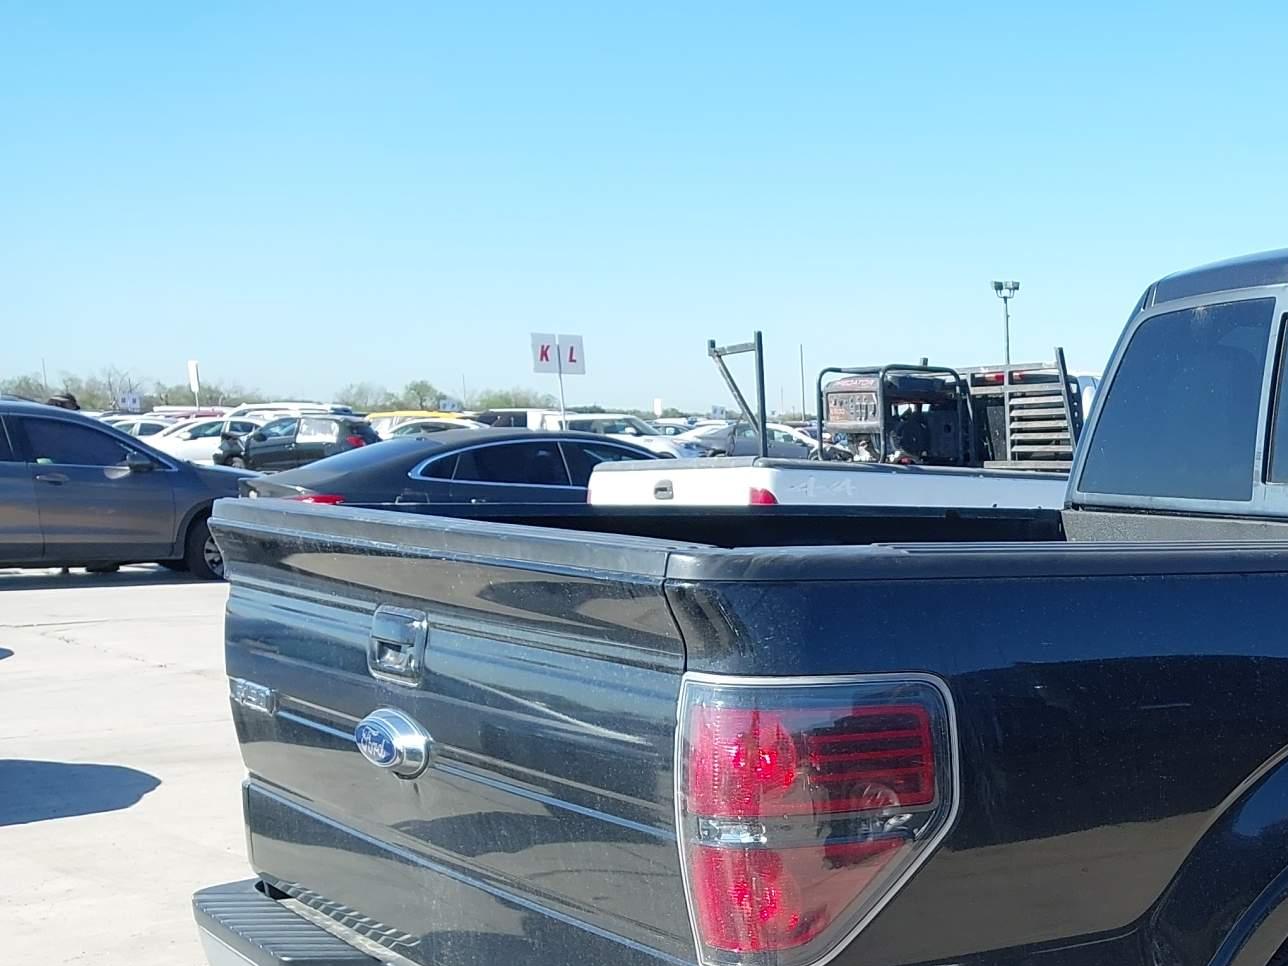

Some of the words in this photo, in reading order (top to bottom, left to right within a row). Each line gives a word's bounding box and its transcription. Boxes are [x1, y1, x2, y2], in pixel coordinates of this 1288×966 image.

[539, 344, 551, 362] K
[568, 345, 577, 363] L
[360, 725, 387, 760] Ford
